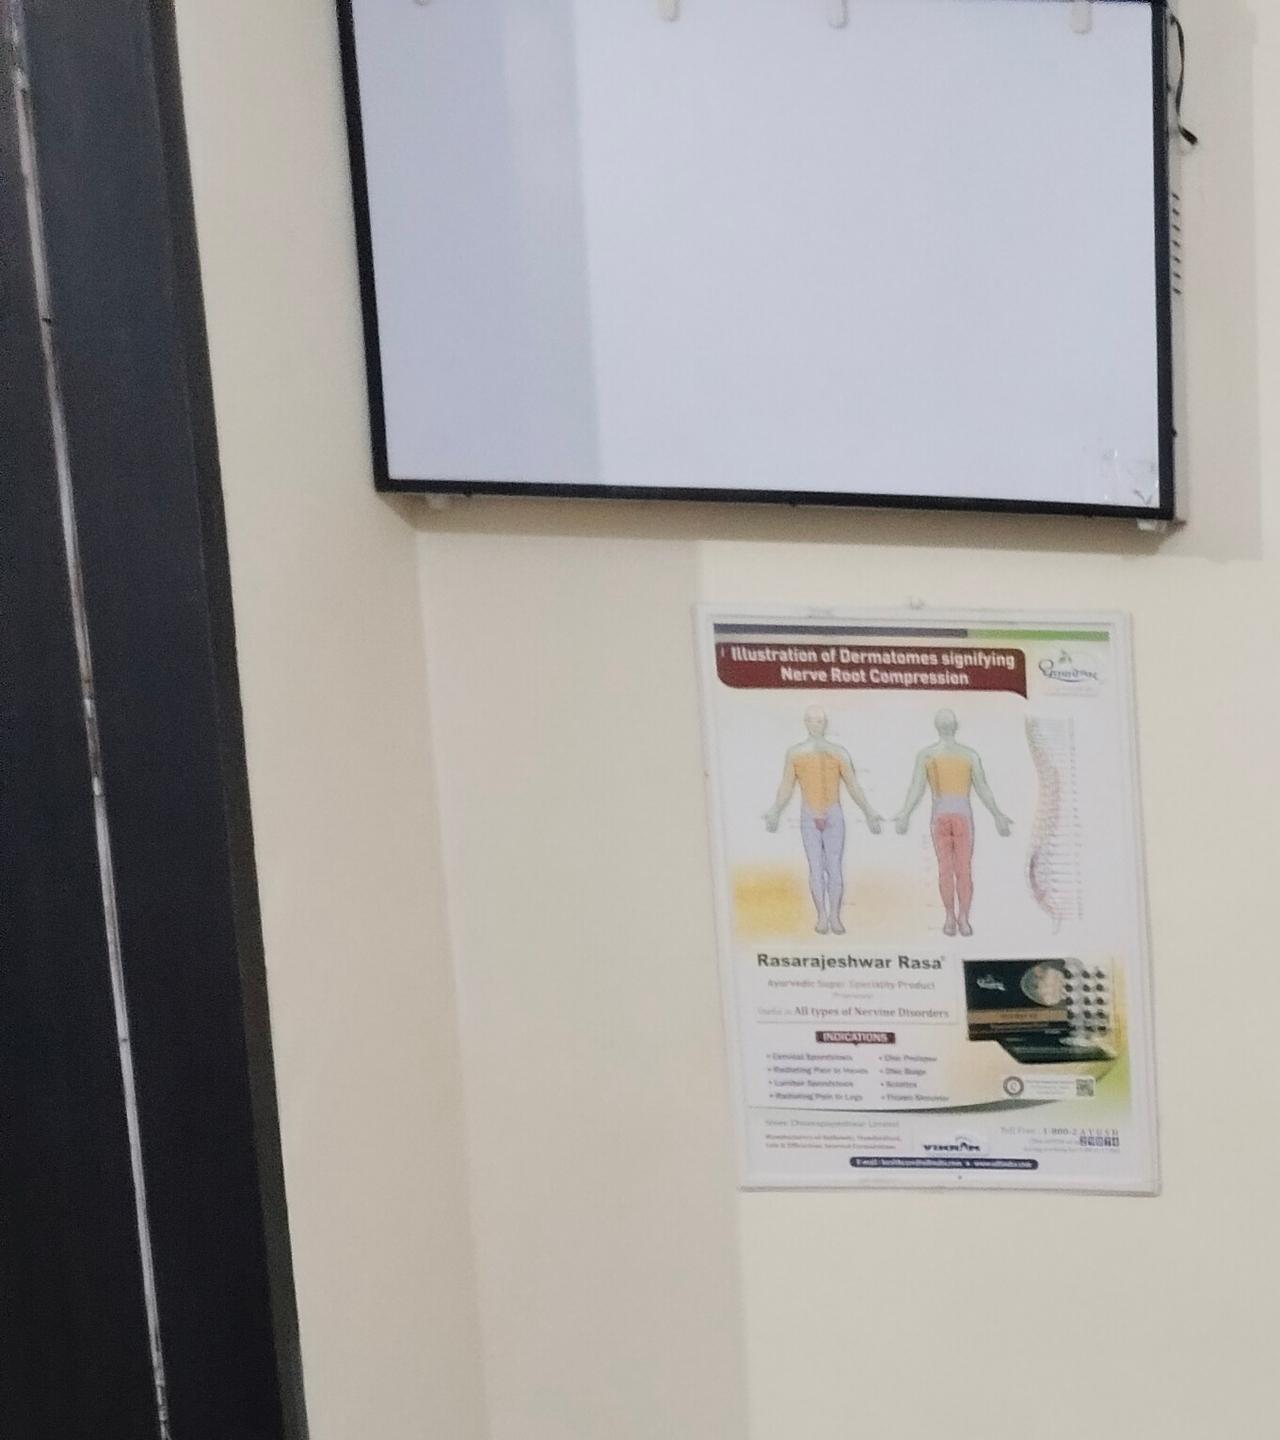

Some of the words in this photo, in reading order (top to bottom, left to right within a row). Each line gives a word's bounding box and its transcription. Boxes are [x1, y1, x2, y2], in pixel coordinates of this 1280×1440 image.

[732, 646, 817, 663] Illustration
[821, 647, 838, 663] of
[840, 648, 938, 666] Dermatomes
[942, 650, 1016, 670] signifying
[780, 667, 828, 683] Nerve
[831, 667, 866, 684] Root
[869, 668, 969, 687] Compression
[757, 953, 892, 972] Rasarajeshwar
[794, 1006, 809, 1016] All
[811, 1007, 839, 1018] types
[842, 1007, 853, 1016] of
[898, 1008, 950, 1018] Disorders
[822, 1032, 889, 1043] INDICATIONS
